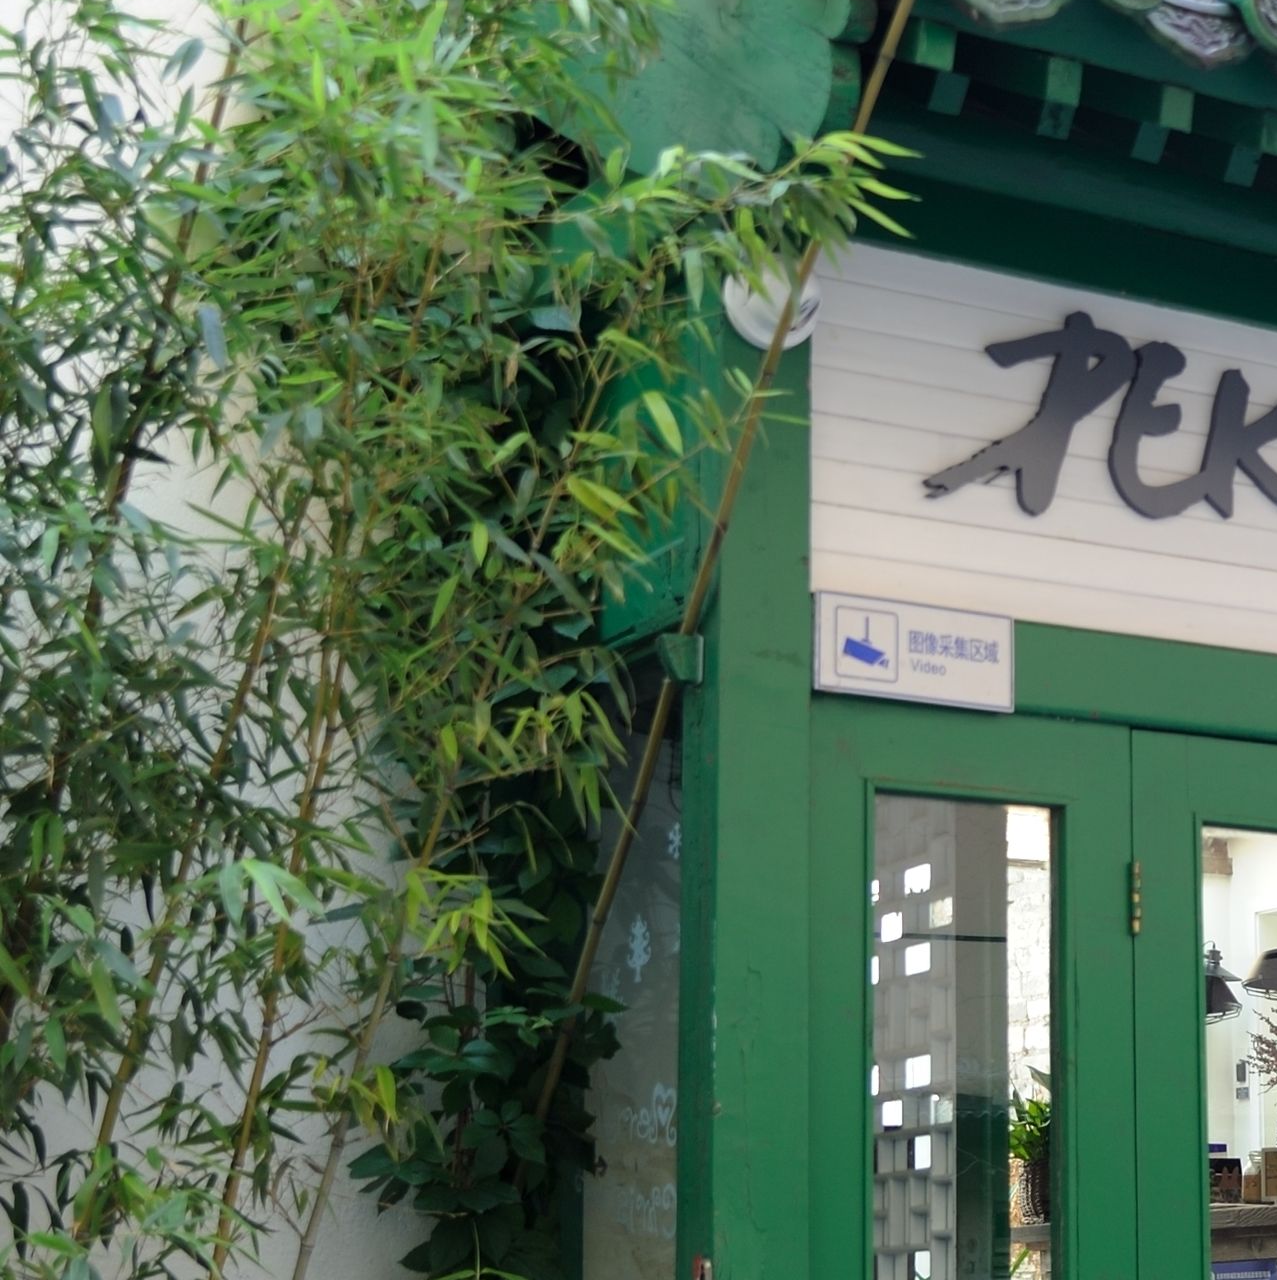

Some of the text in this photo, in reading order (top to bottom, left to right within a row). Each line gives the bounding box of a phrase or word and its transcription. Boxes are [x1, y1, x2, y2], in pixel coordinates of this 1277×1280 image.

[908, 630, 999, 664] 图像采集区域
[911, 658, 947, 676] Video
